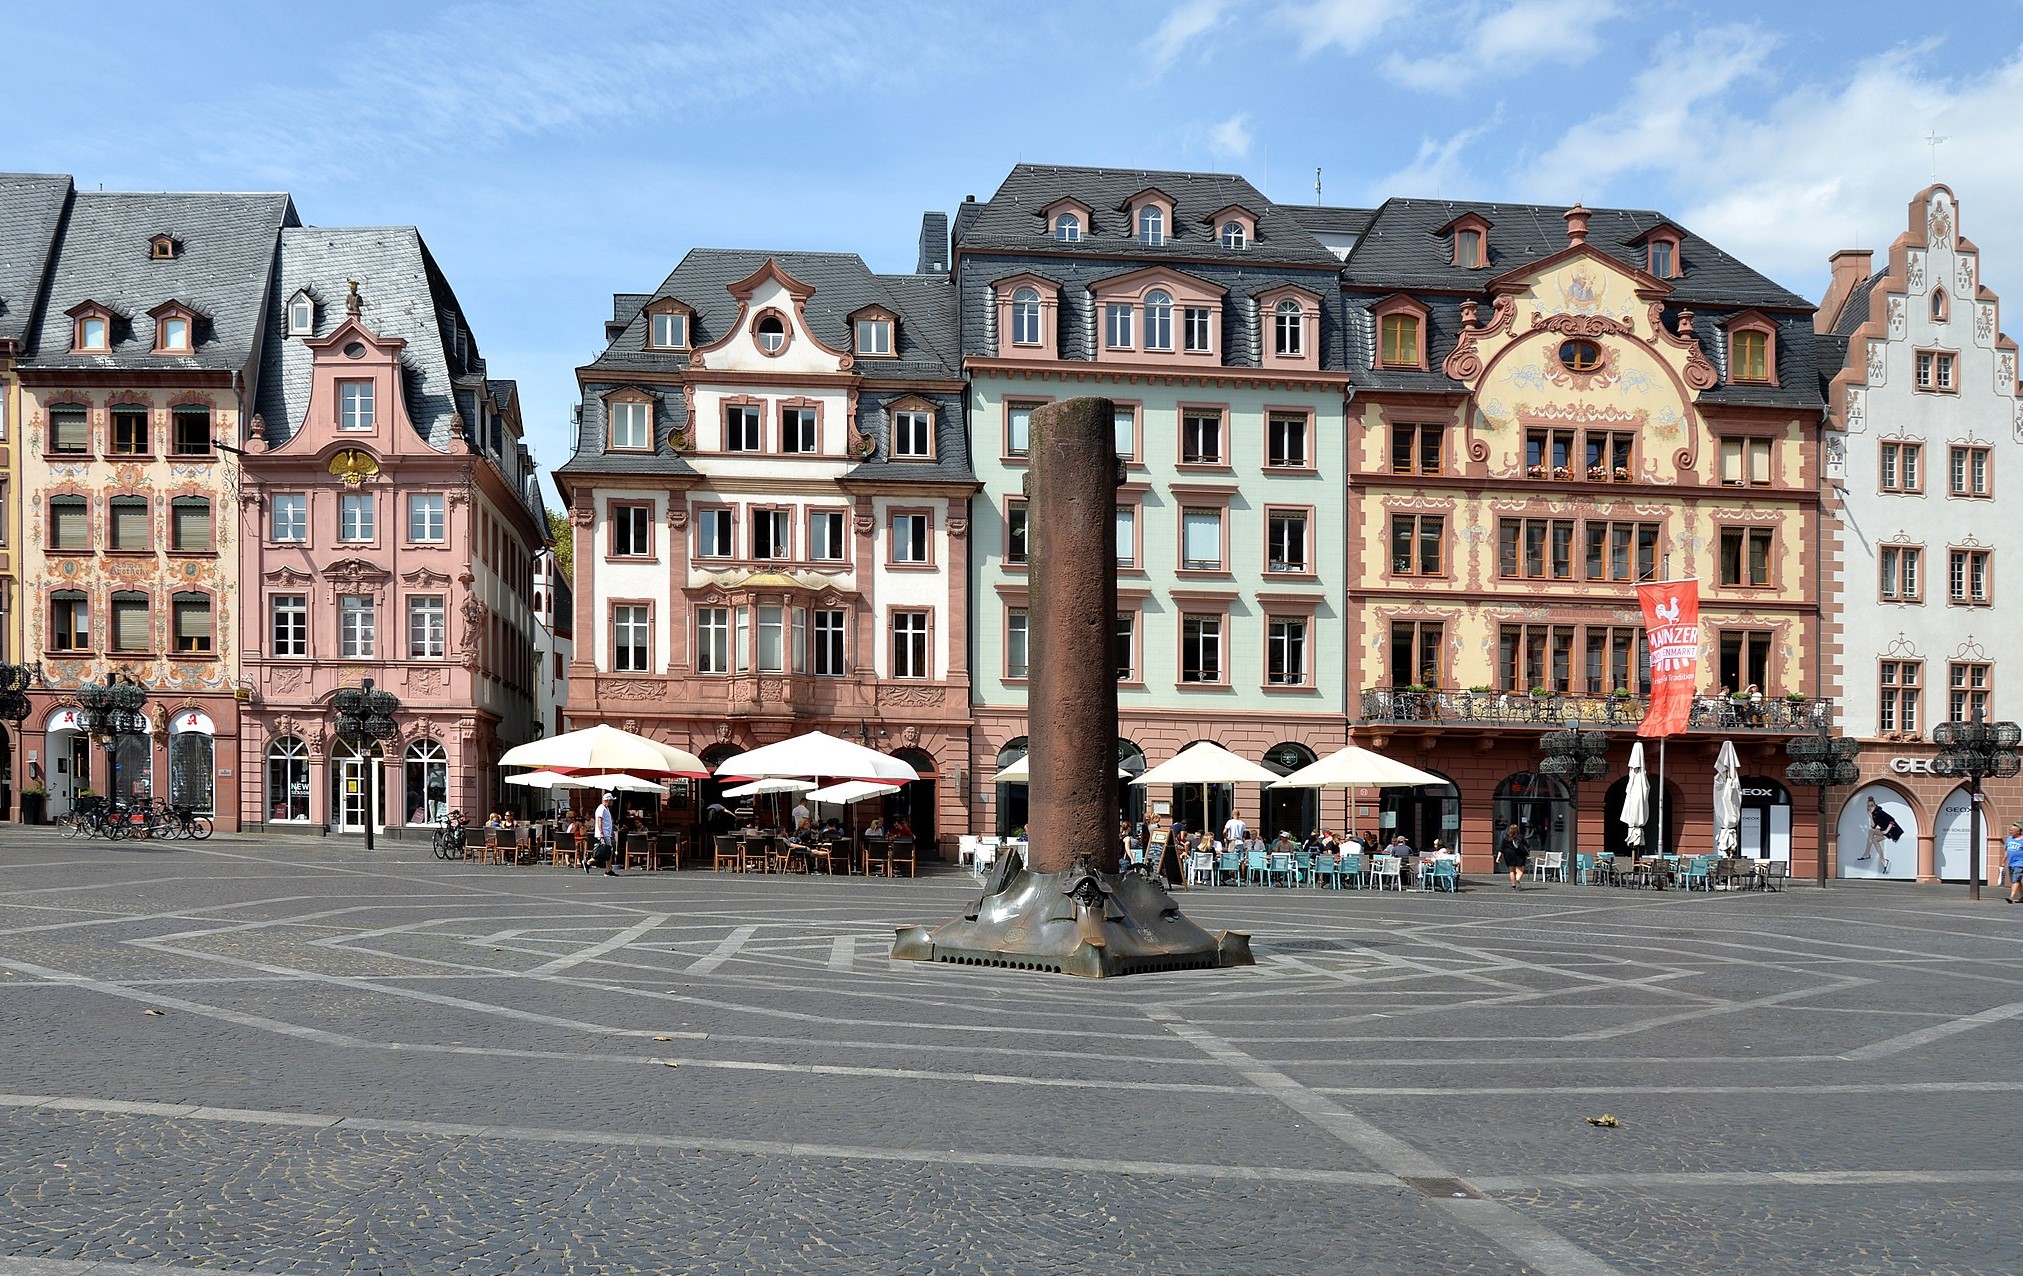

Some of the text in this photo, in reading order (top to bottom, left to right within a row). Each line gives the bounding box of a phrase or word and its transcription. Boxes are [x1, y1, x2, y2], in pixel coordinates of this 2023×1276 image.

[64, 711, 74, 723] A
[187, 713, 197, 725] A
[1890, 757, 1953, 774] GEO
[290, 782, 310, 791] NEW
[1740, 788, 1773, 797] EOX
